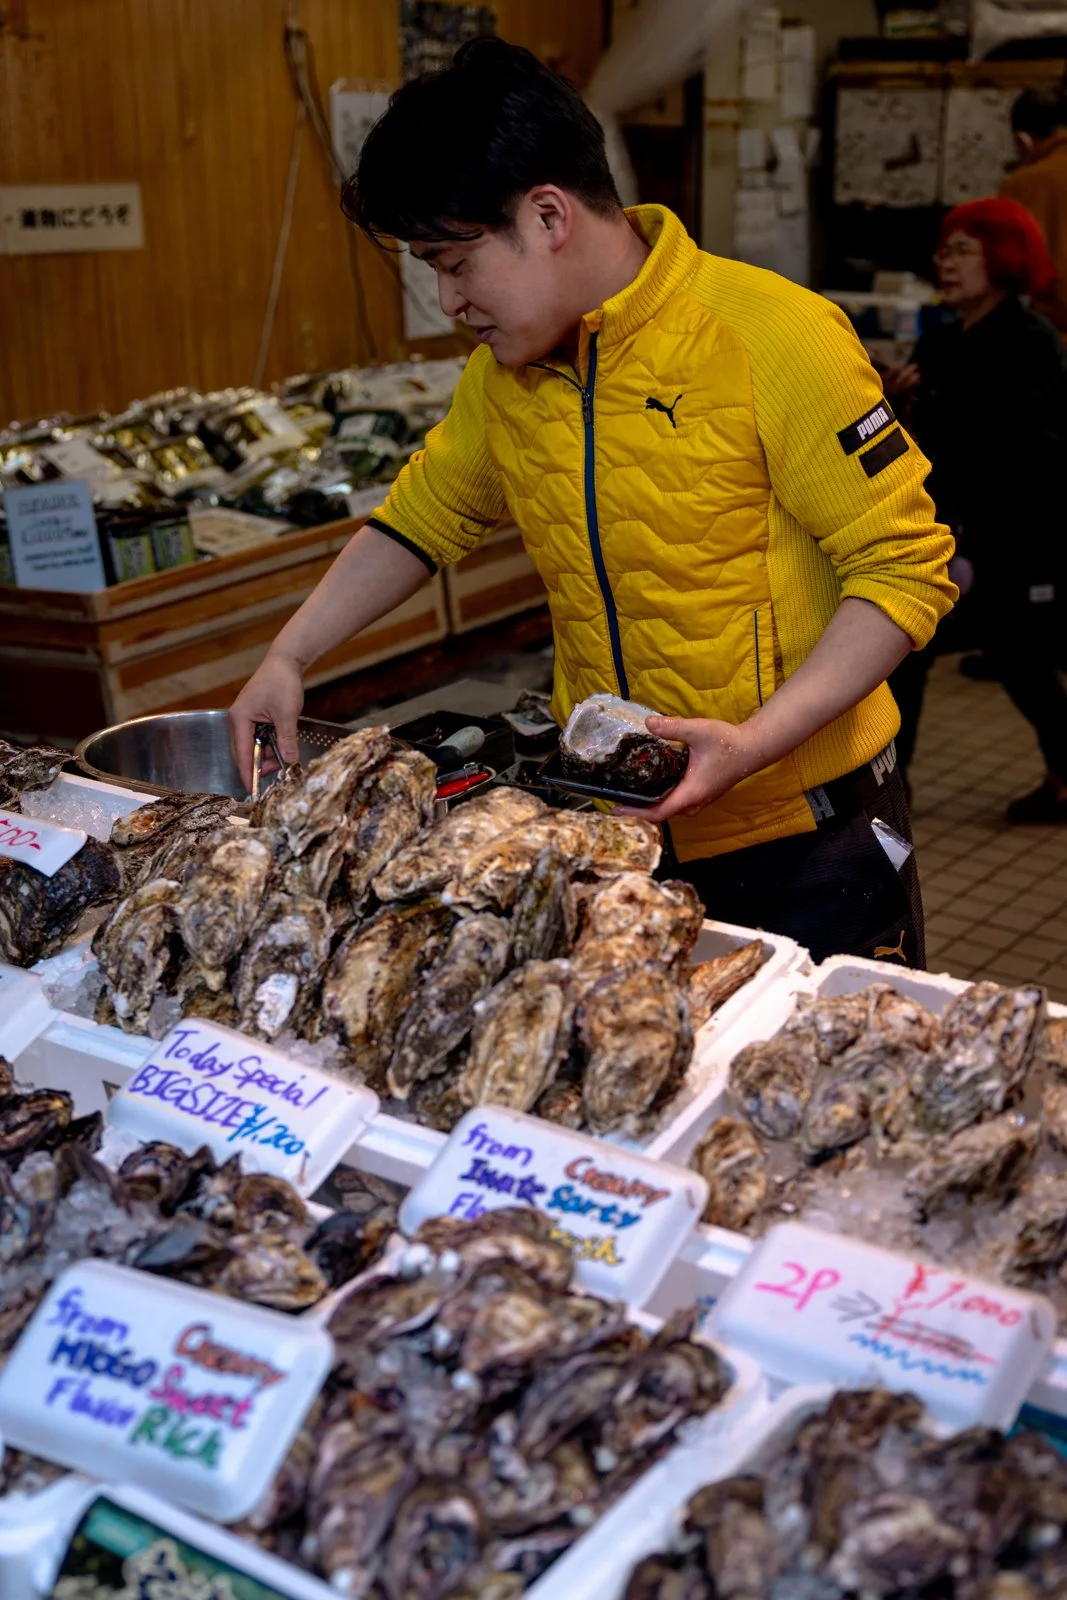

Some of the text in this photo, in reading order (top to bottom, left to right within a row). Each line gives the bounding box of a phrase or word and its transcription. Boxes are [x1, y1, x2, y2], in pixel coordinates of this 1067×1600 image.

[857, 407, 889, 440] PUMA
[164, 1030, 328, 1110] Today Special
[461, 1122, 533, 1168] from
[46, 1286, 128, 1342] from
[754, 1262, 842, 1312] 2P
[149, 1364, 253, 1429] Sweet
[128, 1407, 222, 1469] Rich
